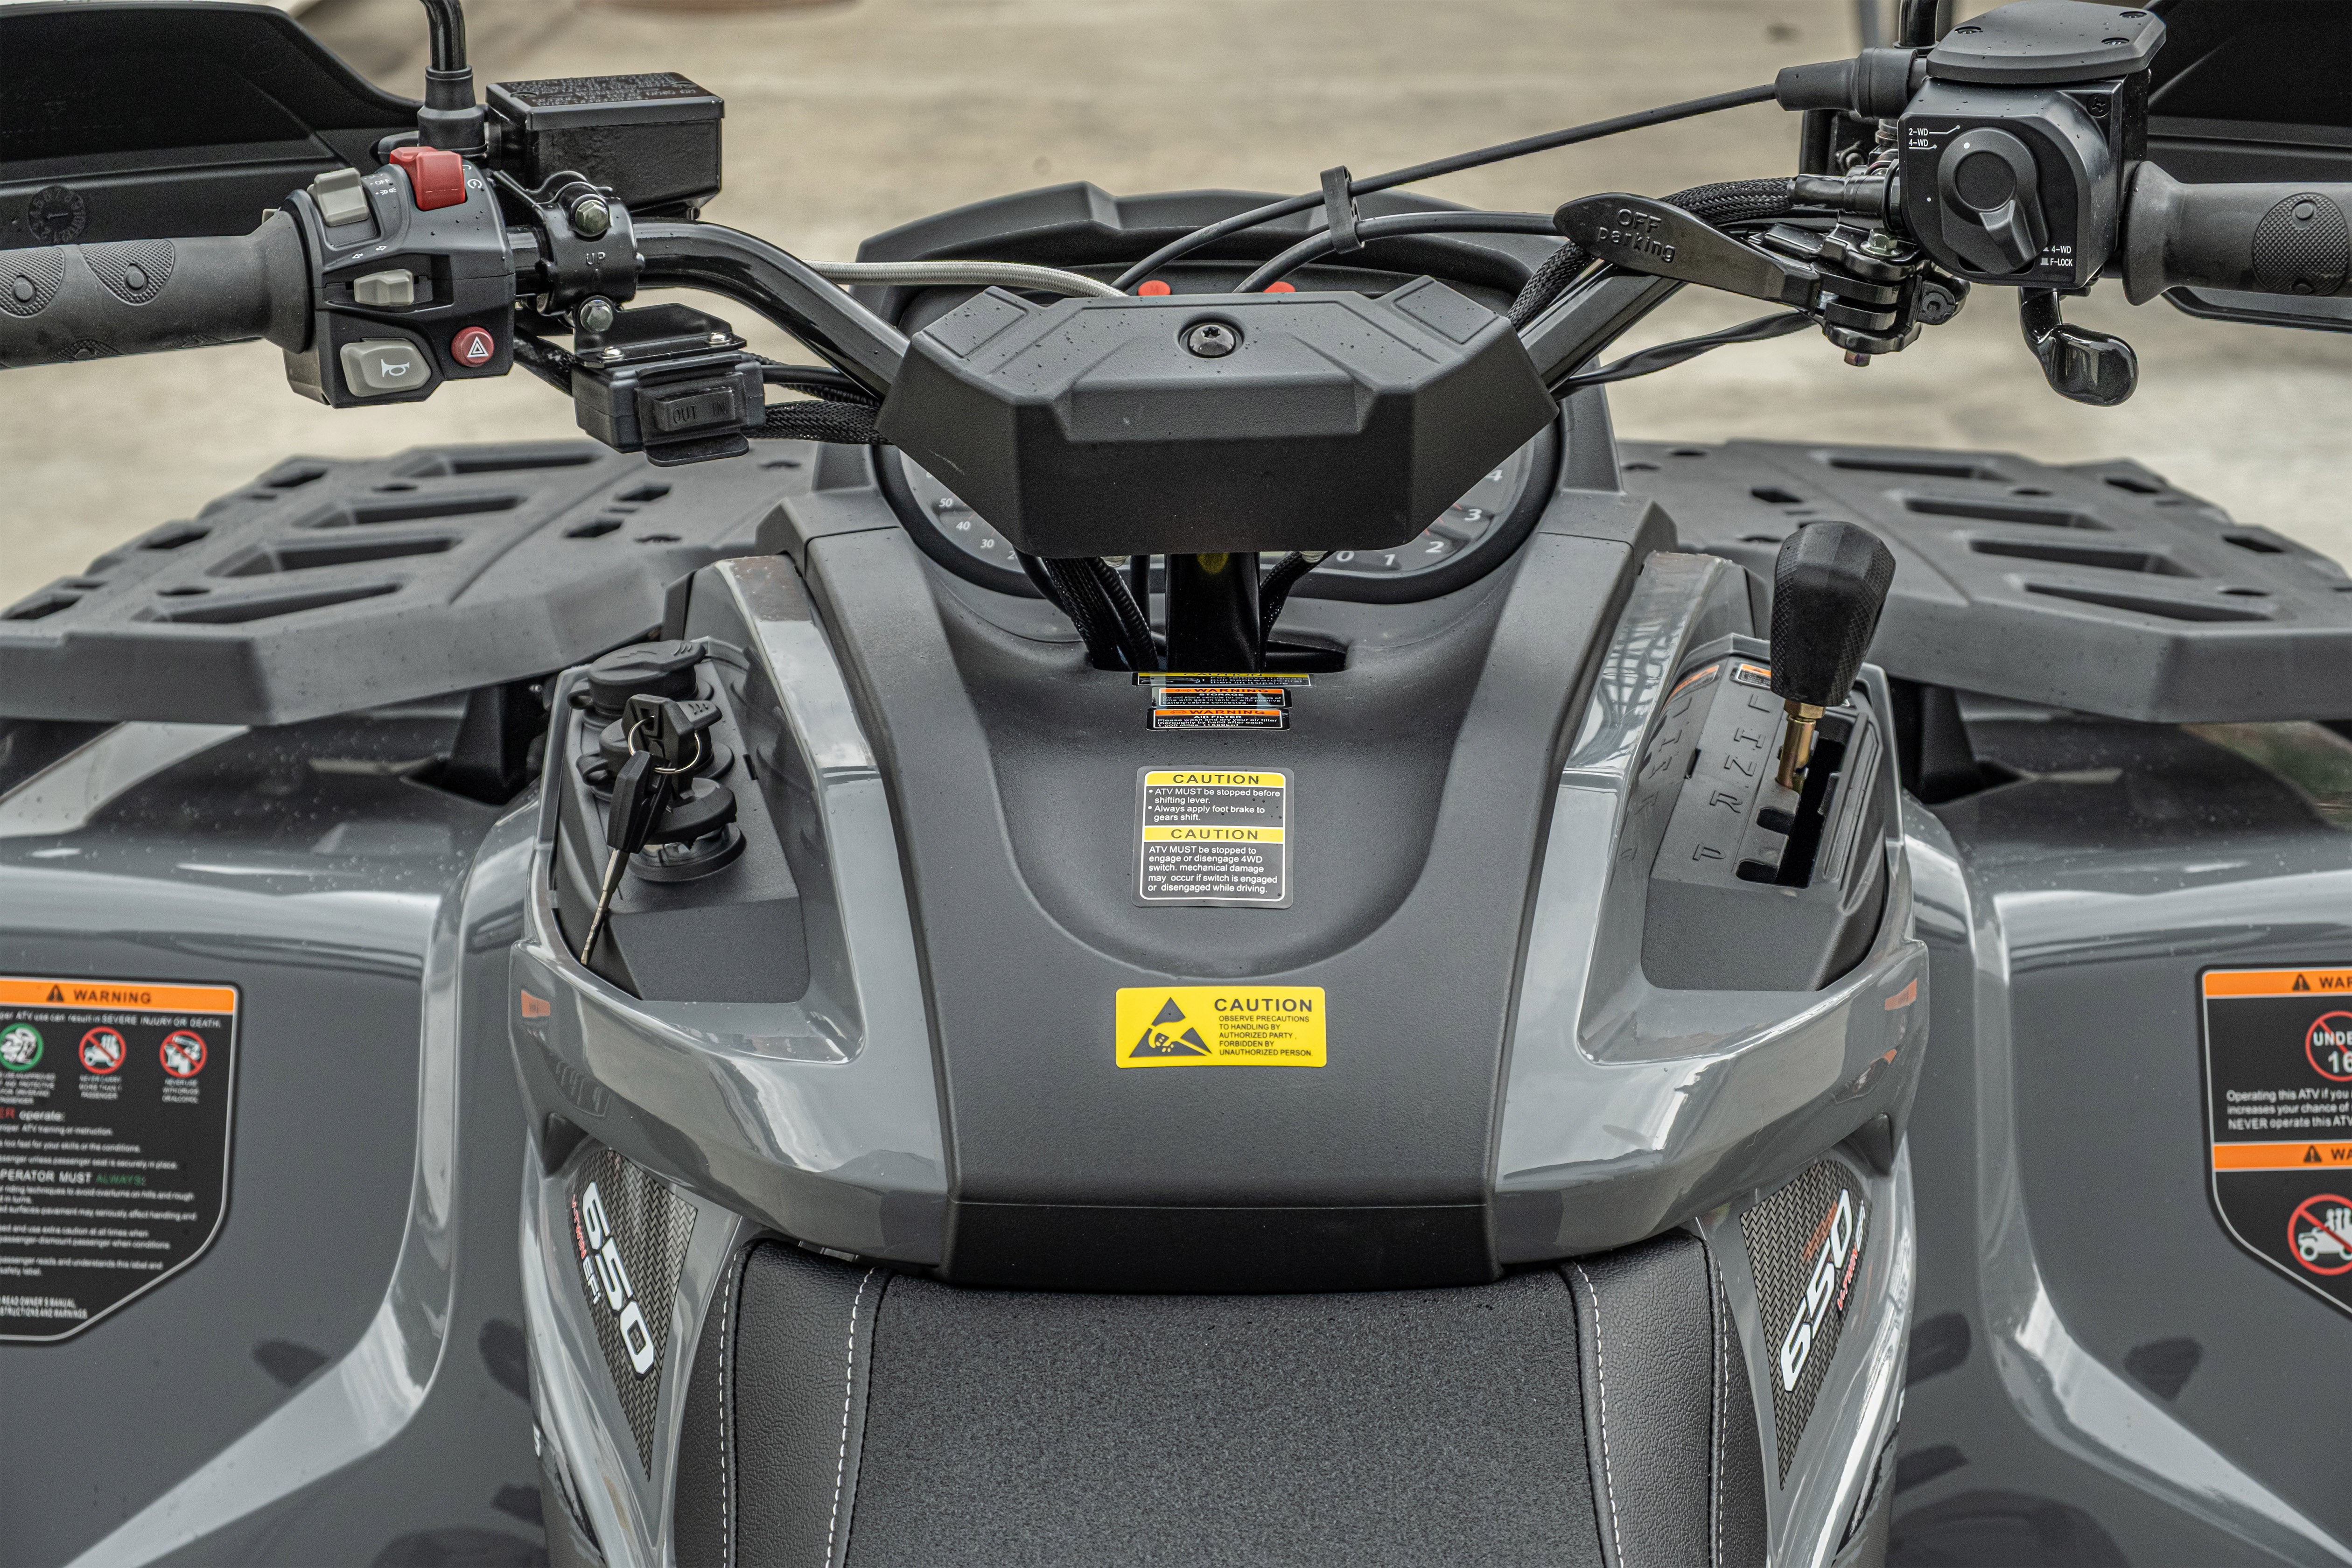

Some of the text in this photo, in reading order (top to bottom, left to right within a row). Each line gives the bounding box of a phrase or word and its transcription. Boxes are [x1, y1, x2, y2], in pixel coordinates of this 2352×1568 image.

[1617, 208, 1662, 234] OFF
[1596, 226, 1676, 263] parking
[2051, 245, 2072, 253] 4-WD
[585, 251, 606, 266] UP
[2050, 258, 2073, 266] F-LOCK
[672, 398, 728, 424] OUT IN
[1486, 469, 1503, 482] 4
[938, 497, 953, 508] 50
[1463, 508, 1484, 522] 3
[955, 520, 971, 531] 40
[980, 539, 995, 549] 30
[1425, 540, 1445, 553] 2
[1336, 550, 1355, 562] 0
[1384, 553, 1396, 566] 1
[1173, 774, 1259, 784] CAUTION
[1217, 789, 1251, 797] stopped
[1709, 790, 1743, 814] R
[1154, 805, 1185, 813] Always
[1187, 805, 1211, 814] apply
[1170, 829, 1258, 840] CAUTION
[1211, 847, 1246, 855] stopped
[1692, 843, 1727, 861] P
[1194, 854, 1239, 864] disengage
[1180, 864, 1228, 872] mechanical
[1229, 864, 1264, 875] damage
[1203, 874, 1230, 882] switch
[1240, 876, 1278, 885] engaged
[1161, 883, 1211, 893] disengaged
[1212, 883, 1235, 892] while
[1237, 884, 1268, 895] driving.
[73, 989, 151, 1005] WARNING
[1214, 998, 1312, 1012] CAUTION
[101, 1014, 137, 1026] SEVERE
[140, 1015, 172, 1027] INJURY
[173, 1016, 187, 1027] OR
[2226, 1088, 2349, 1103] Operating this ATV if you
[2227, 1101, 2349, 1116] increases your chance of
[2228, 1117, 2268, 1130] NEVER
[2269, 1116, 2311, 1130] operate
[2312, 1116, 2332, 1127] this
[59, 1170, 93, 1184] MUST
[582, 1181, 654, 1375] 650
[1780, 1188, 1853, 1392] 650
